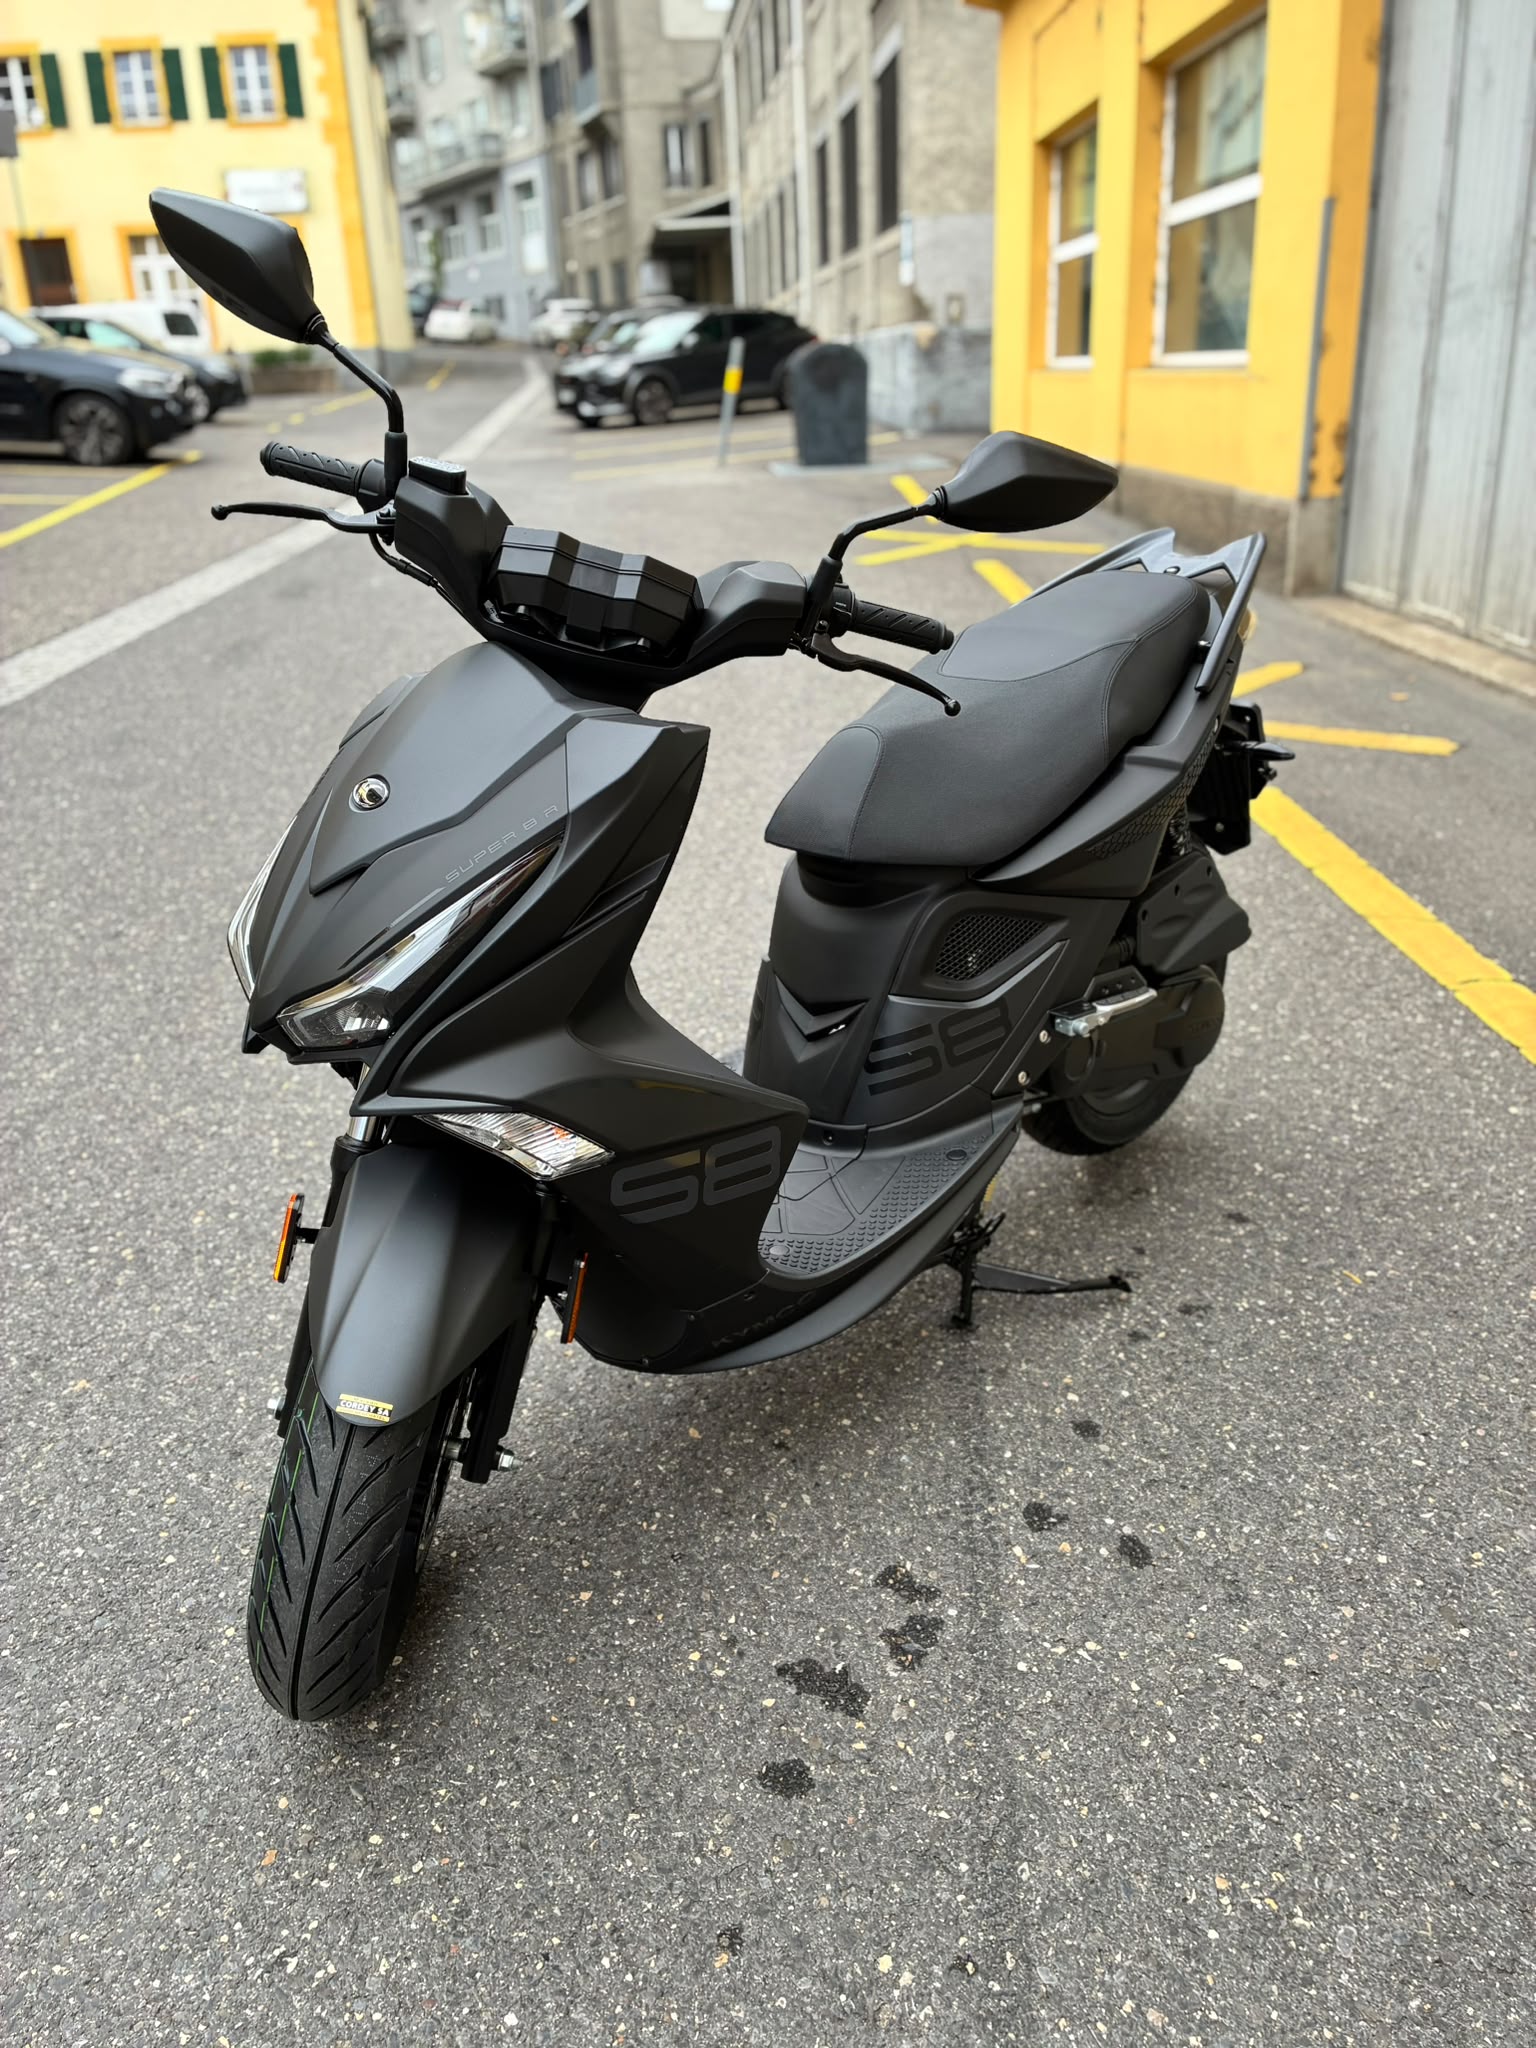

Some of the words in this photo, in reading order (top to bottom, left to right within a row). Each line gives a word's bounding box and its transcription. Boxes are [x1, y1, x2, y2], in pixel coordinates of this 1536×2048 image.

[445, 831, 518, 884] SUPER
[543, 804, 559, 818] R
[610, 1125, 782, 1225] S8
[340, 1400, 376, 1413] CORDEY
[377, 1407, 389, 1417] SA
